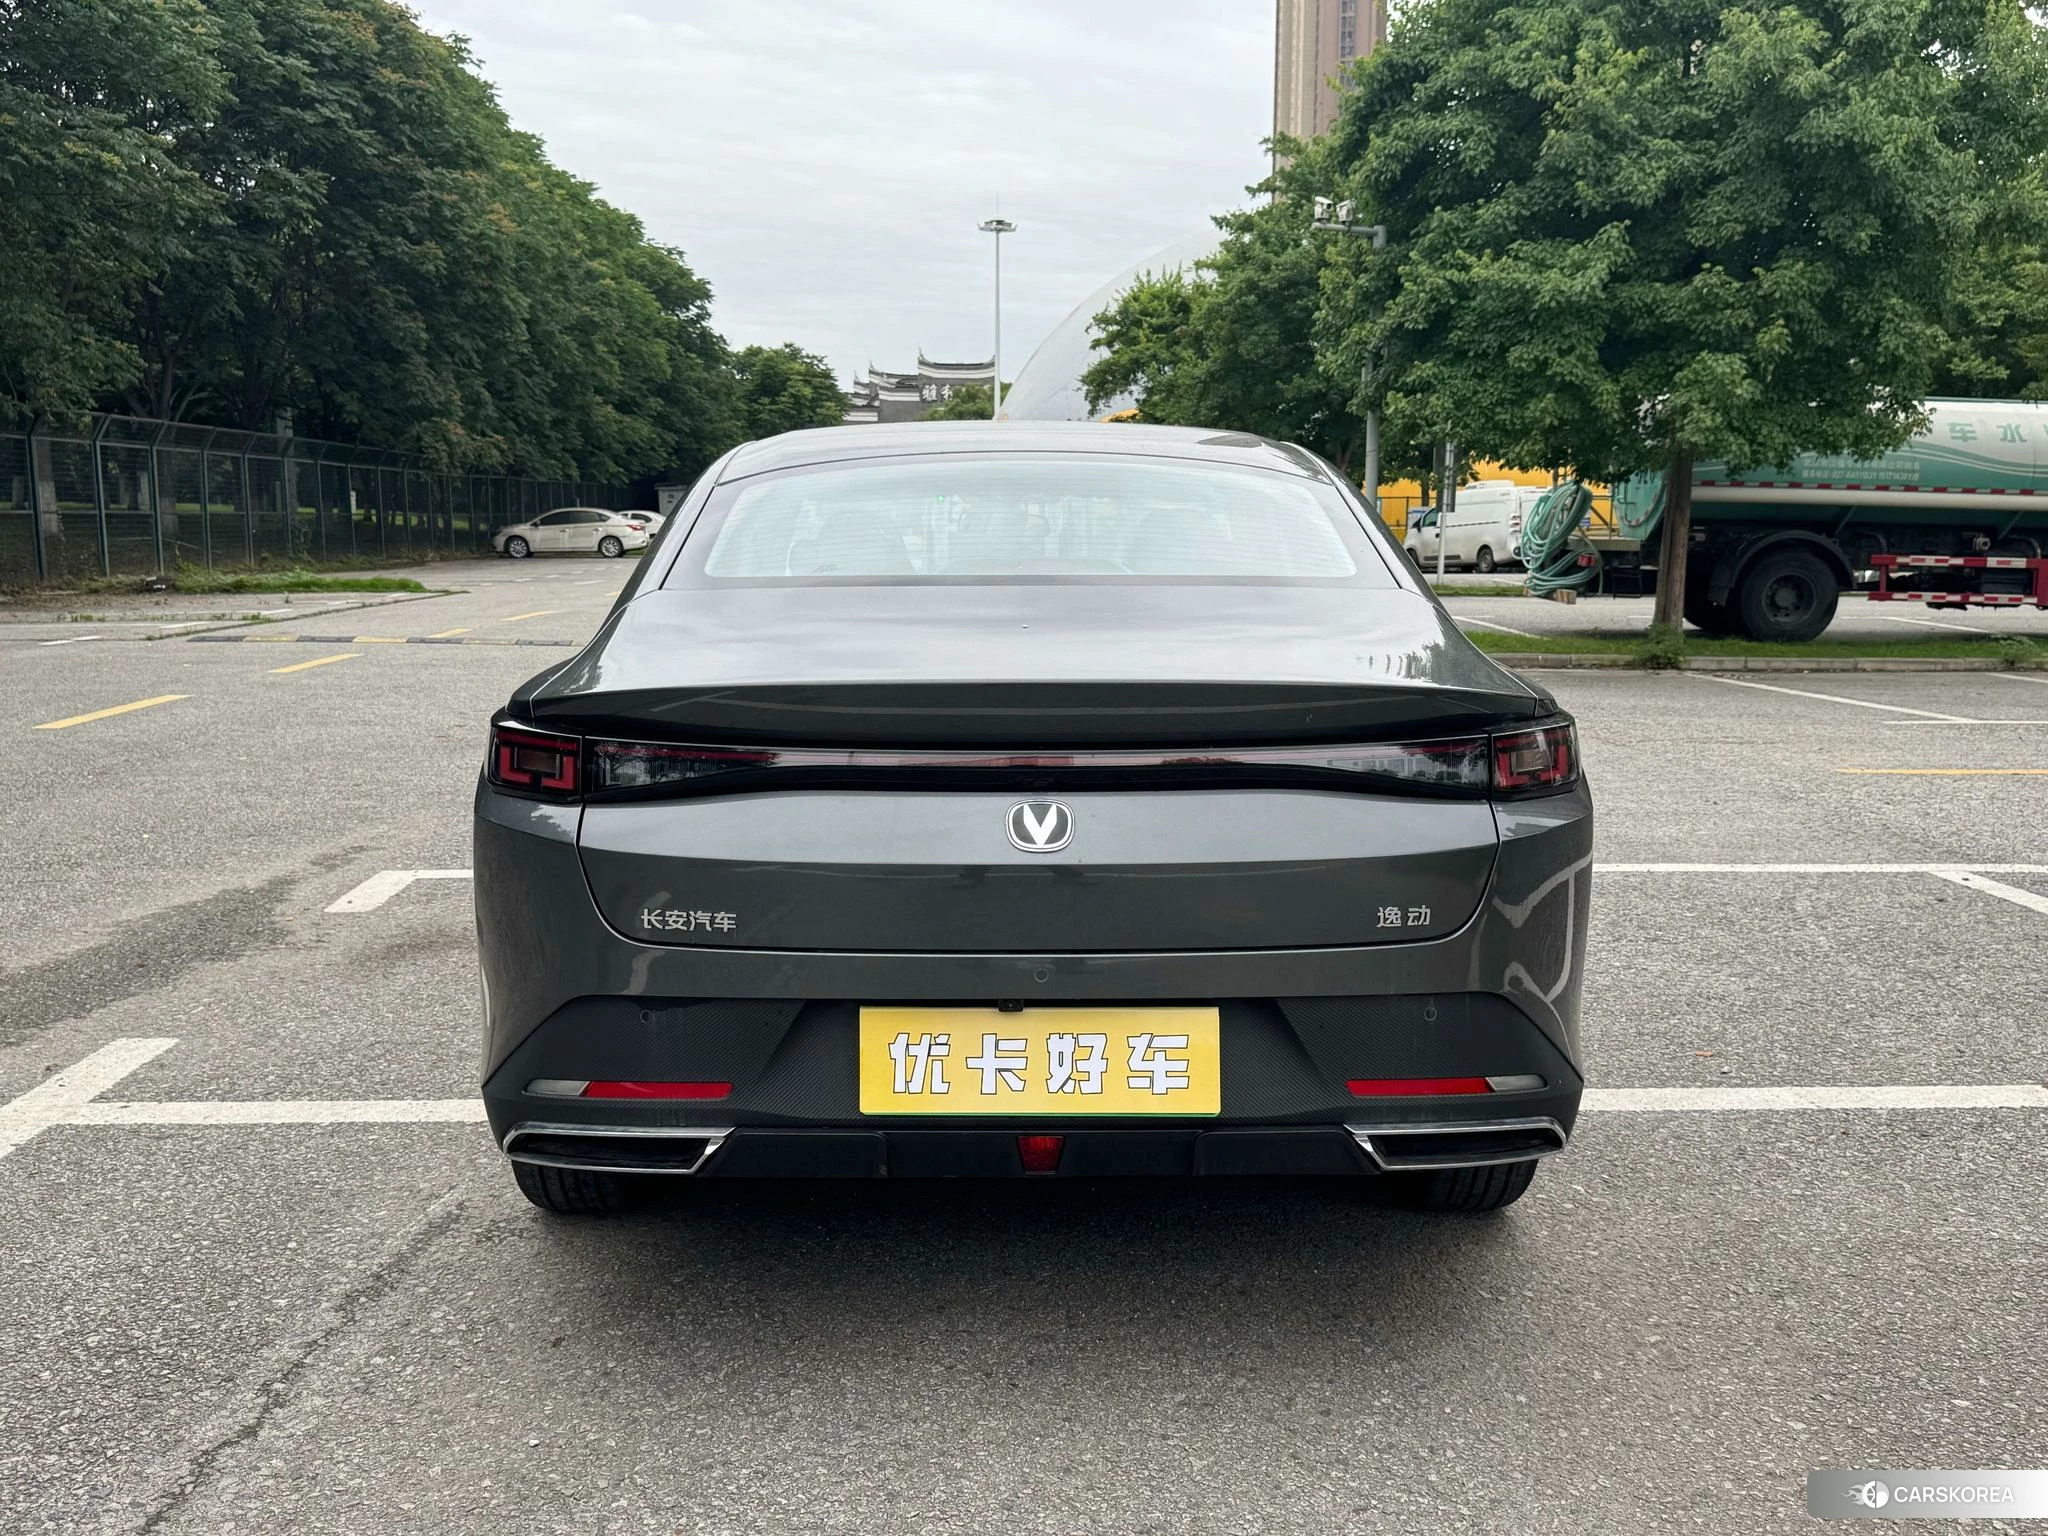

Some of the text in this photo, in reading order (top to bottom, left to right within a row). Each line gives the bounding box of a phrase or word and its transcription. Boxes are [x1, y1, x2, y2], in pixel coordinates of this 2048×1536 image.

[641, 908, 737, 933] 长安汽车
[1376, 904, 1431, 928] 逸动
[888, 1032, 1189, 1095] 优卡好车
